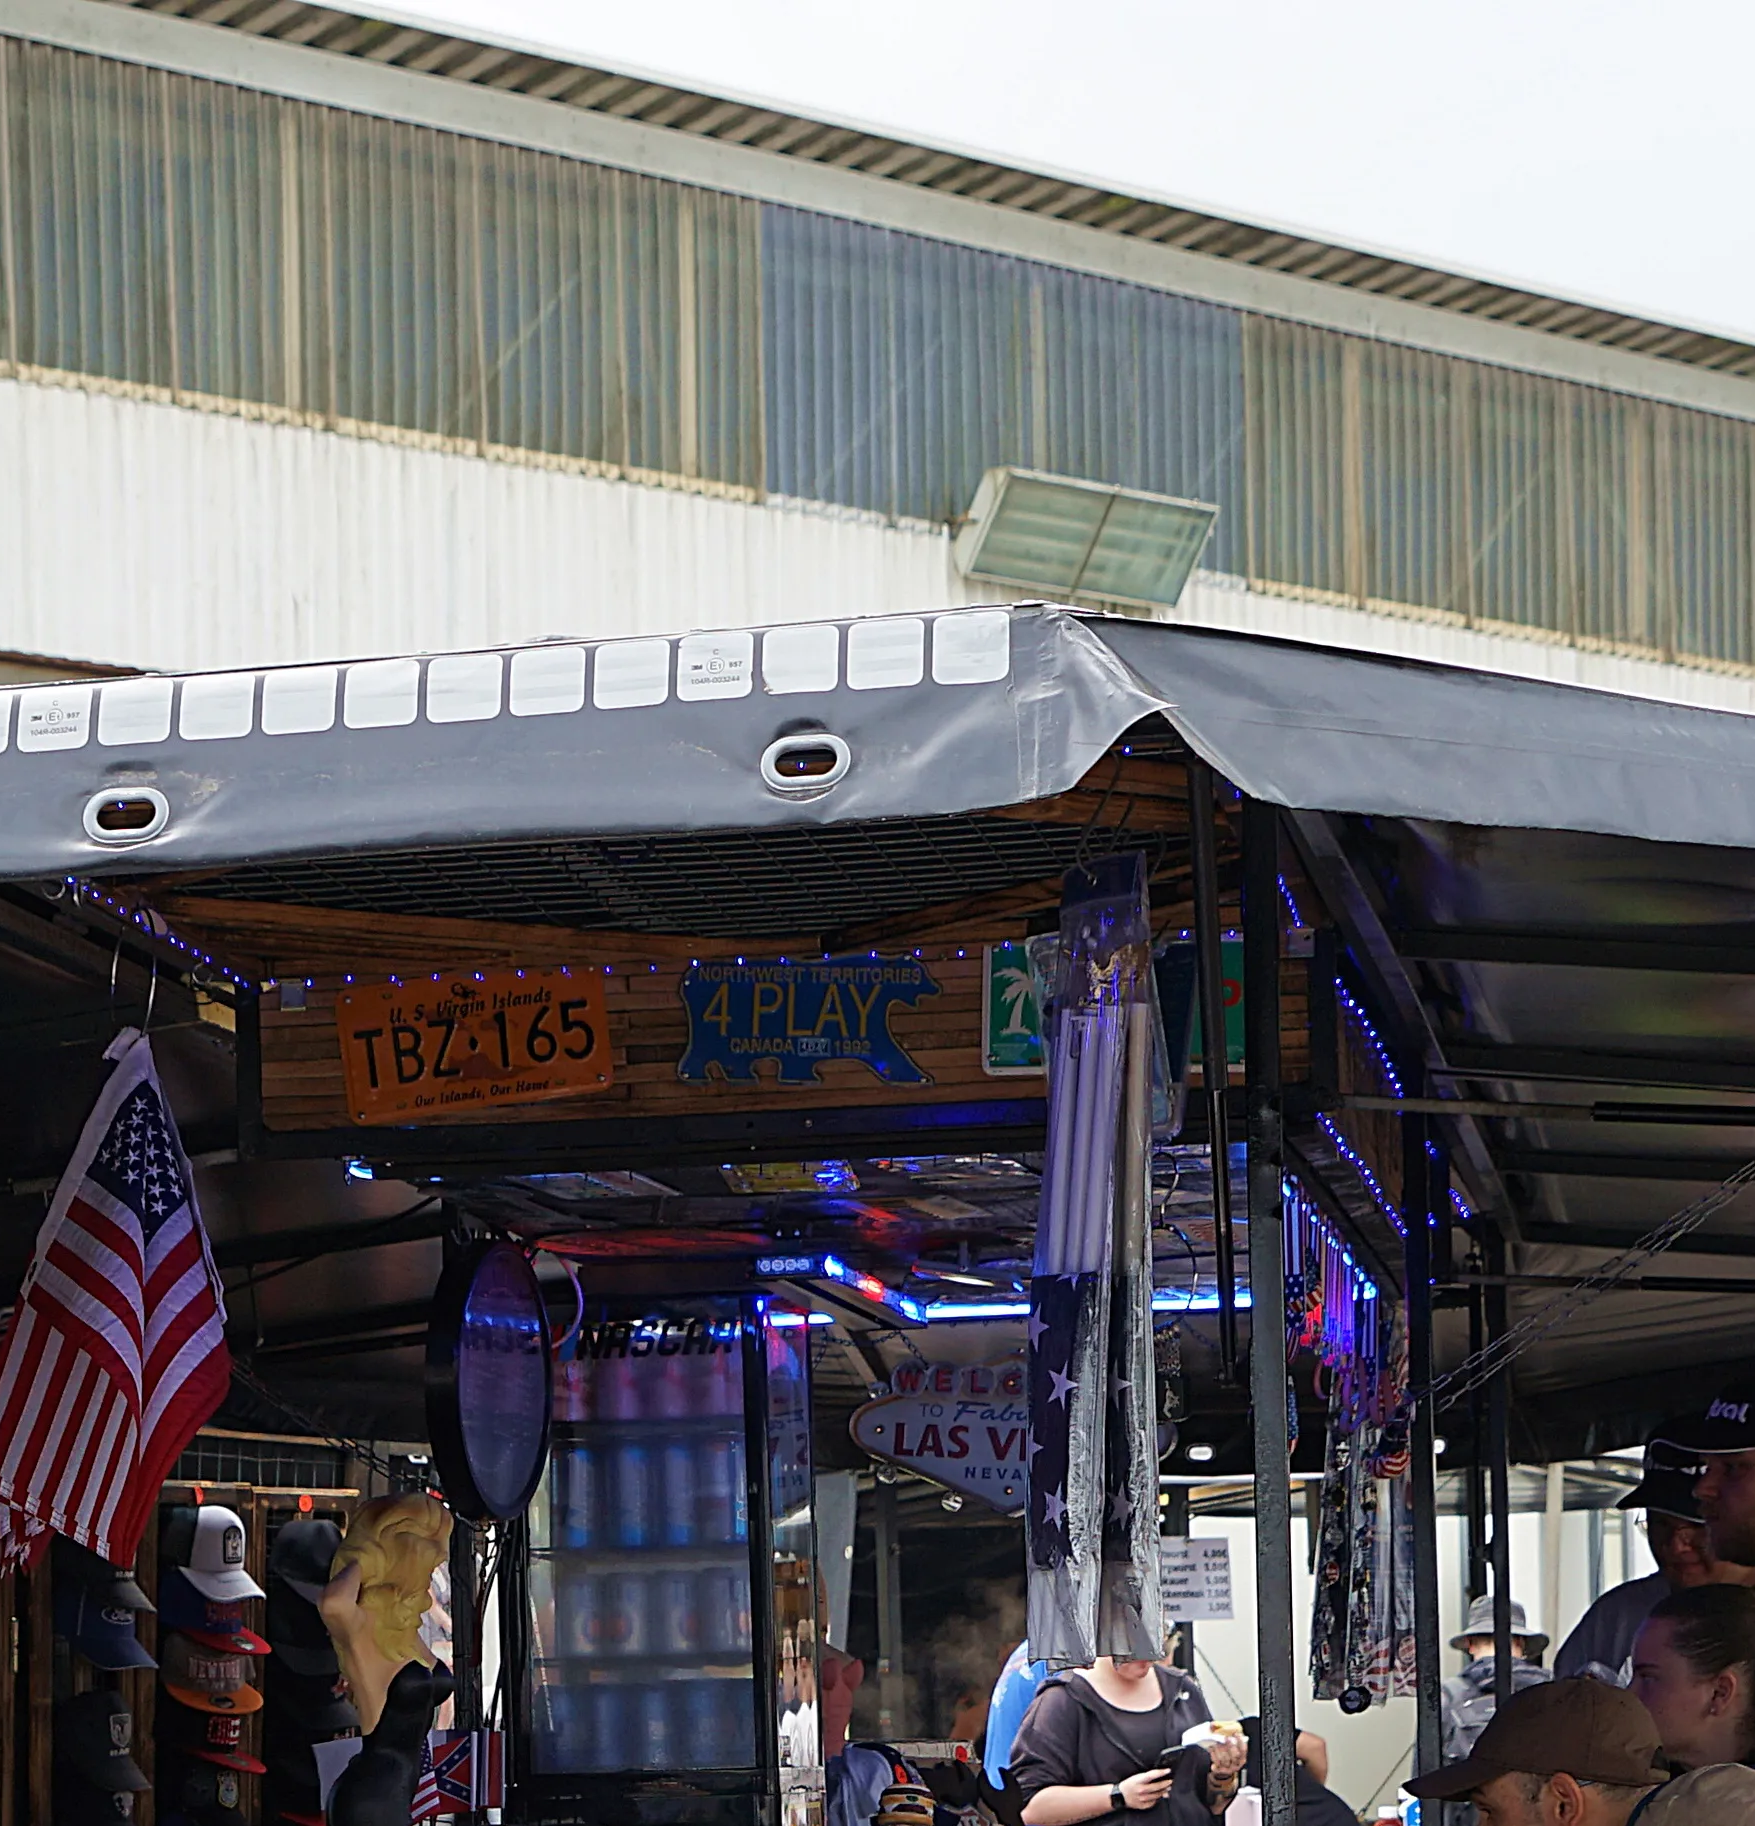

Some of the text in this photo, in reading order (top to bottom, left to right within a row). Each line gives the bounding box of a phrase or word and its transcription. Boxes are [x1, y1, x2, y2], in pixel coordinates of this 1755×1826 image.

[697, 964, 923, 985] NORTHWEST TERRITORIES
[434, 993, 487, 1023] Virgin
[490, 987, 553, 1011] Islands
[702, 982, 883, 1038] 4 PLAY
[729, 1037, 795, 1054] CANADA
[833, 1039, 872, 1055] 1992
[414, 1076, 551, 1108] Our Islands, Our Home
[919, 1401, 944, 1418] TO
[893, 1422, 971, 1459] LAS
